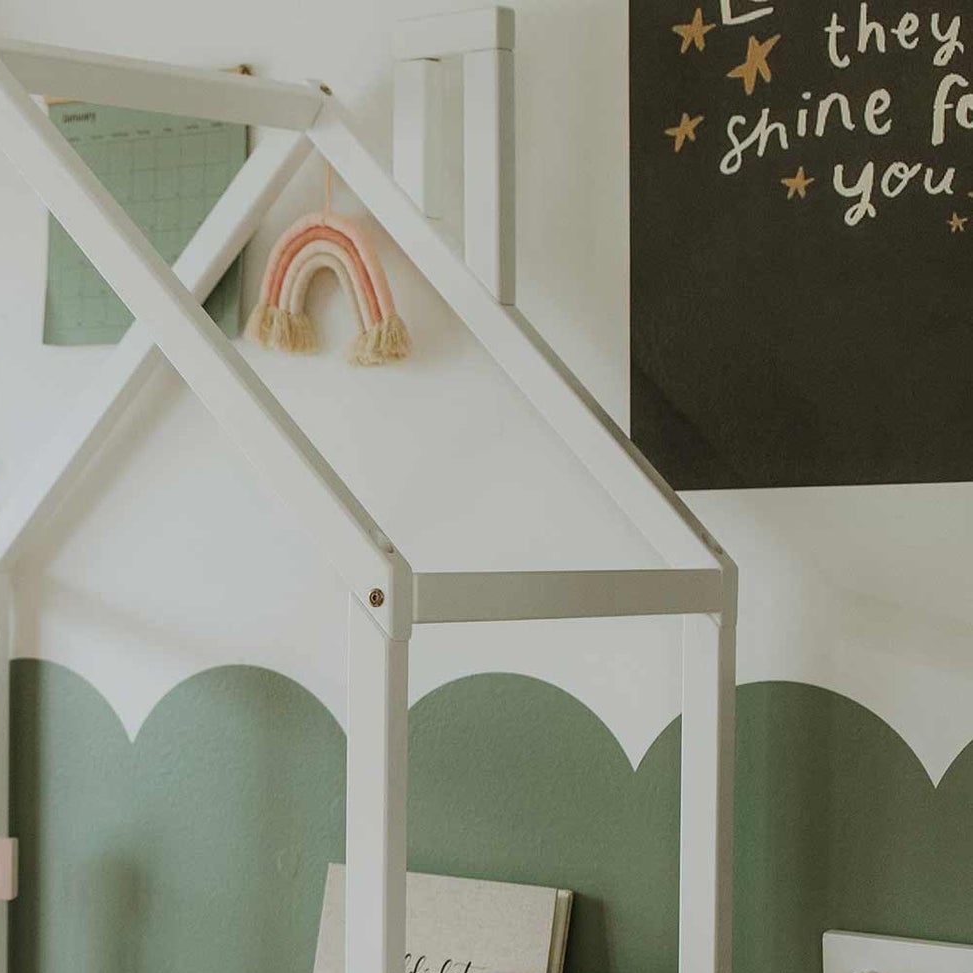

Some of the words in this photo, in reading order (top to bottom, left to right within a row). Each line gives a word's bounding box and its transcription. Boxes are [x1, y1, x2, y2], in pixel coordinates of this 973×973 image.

[824, 2, 964, 68] they
[719, 88, 892, 175] shine
[832, 161, 956, 226] you
